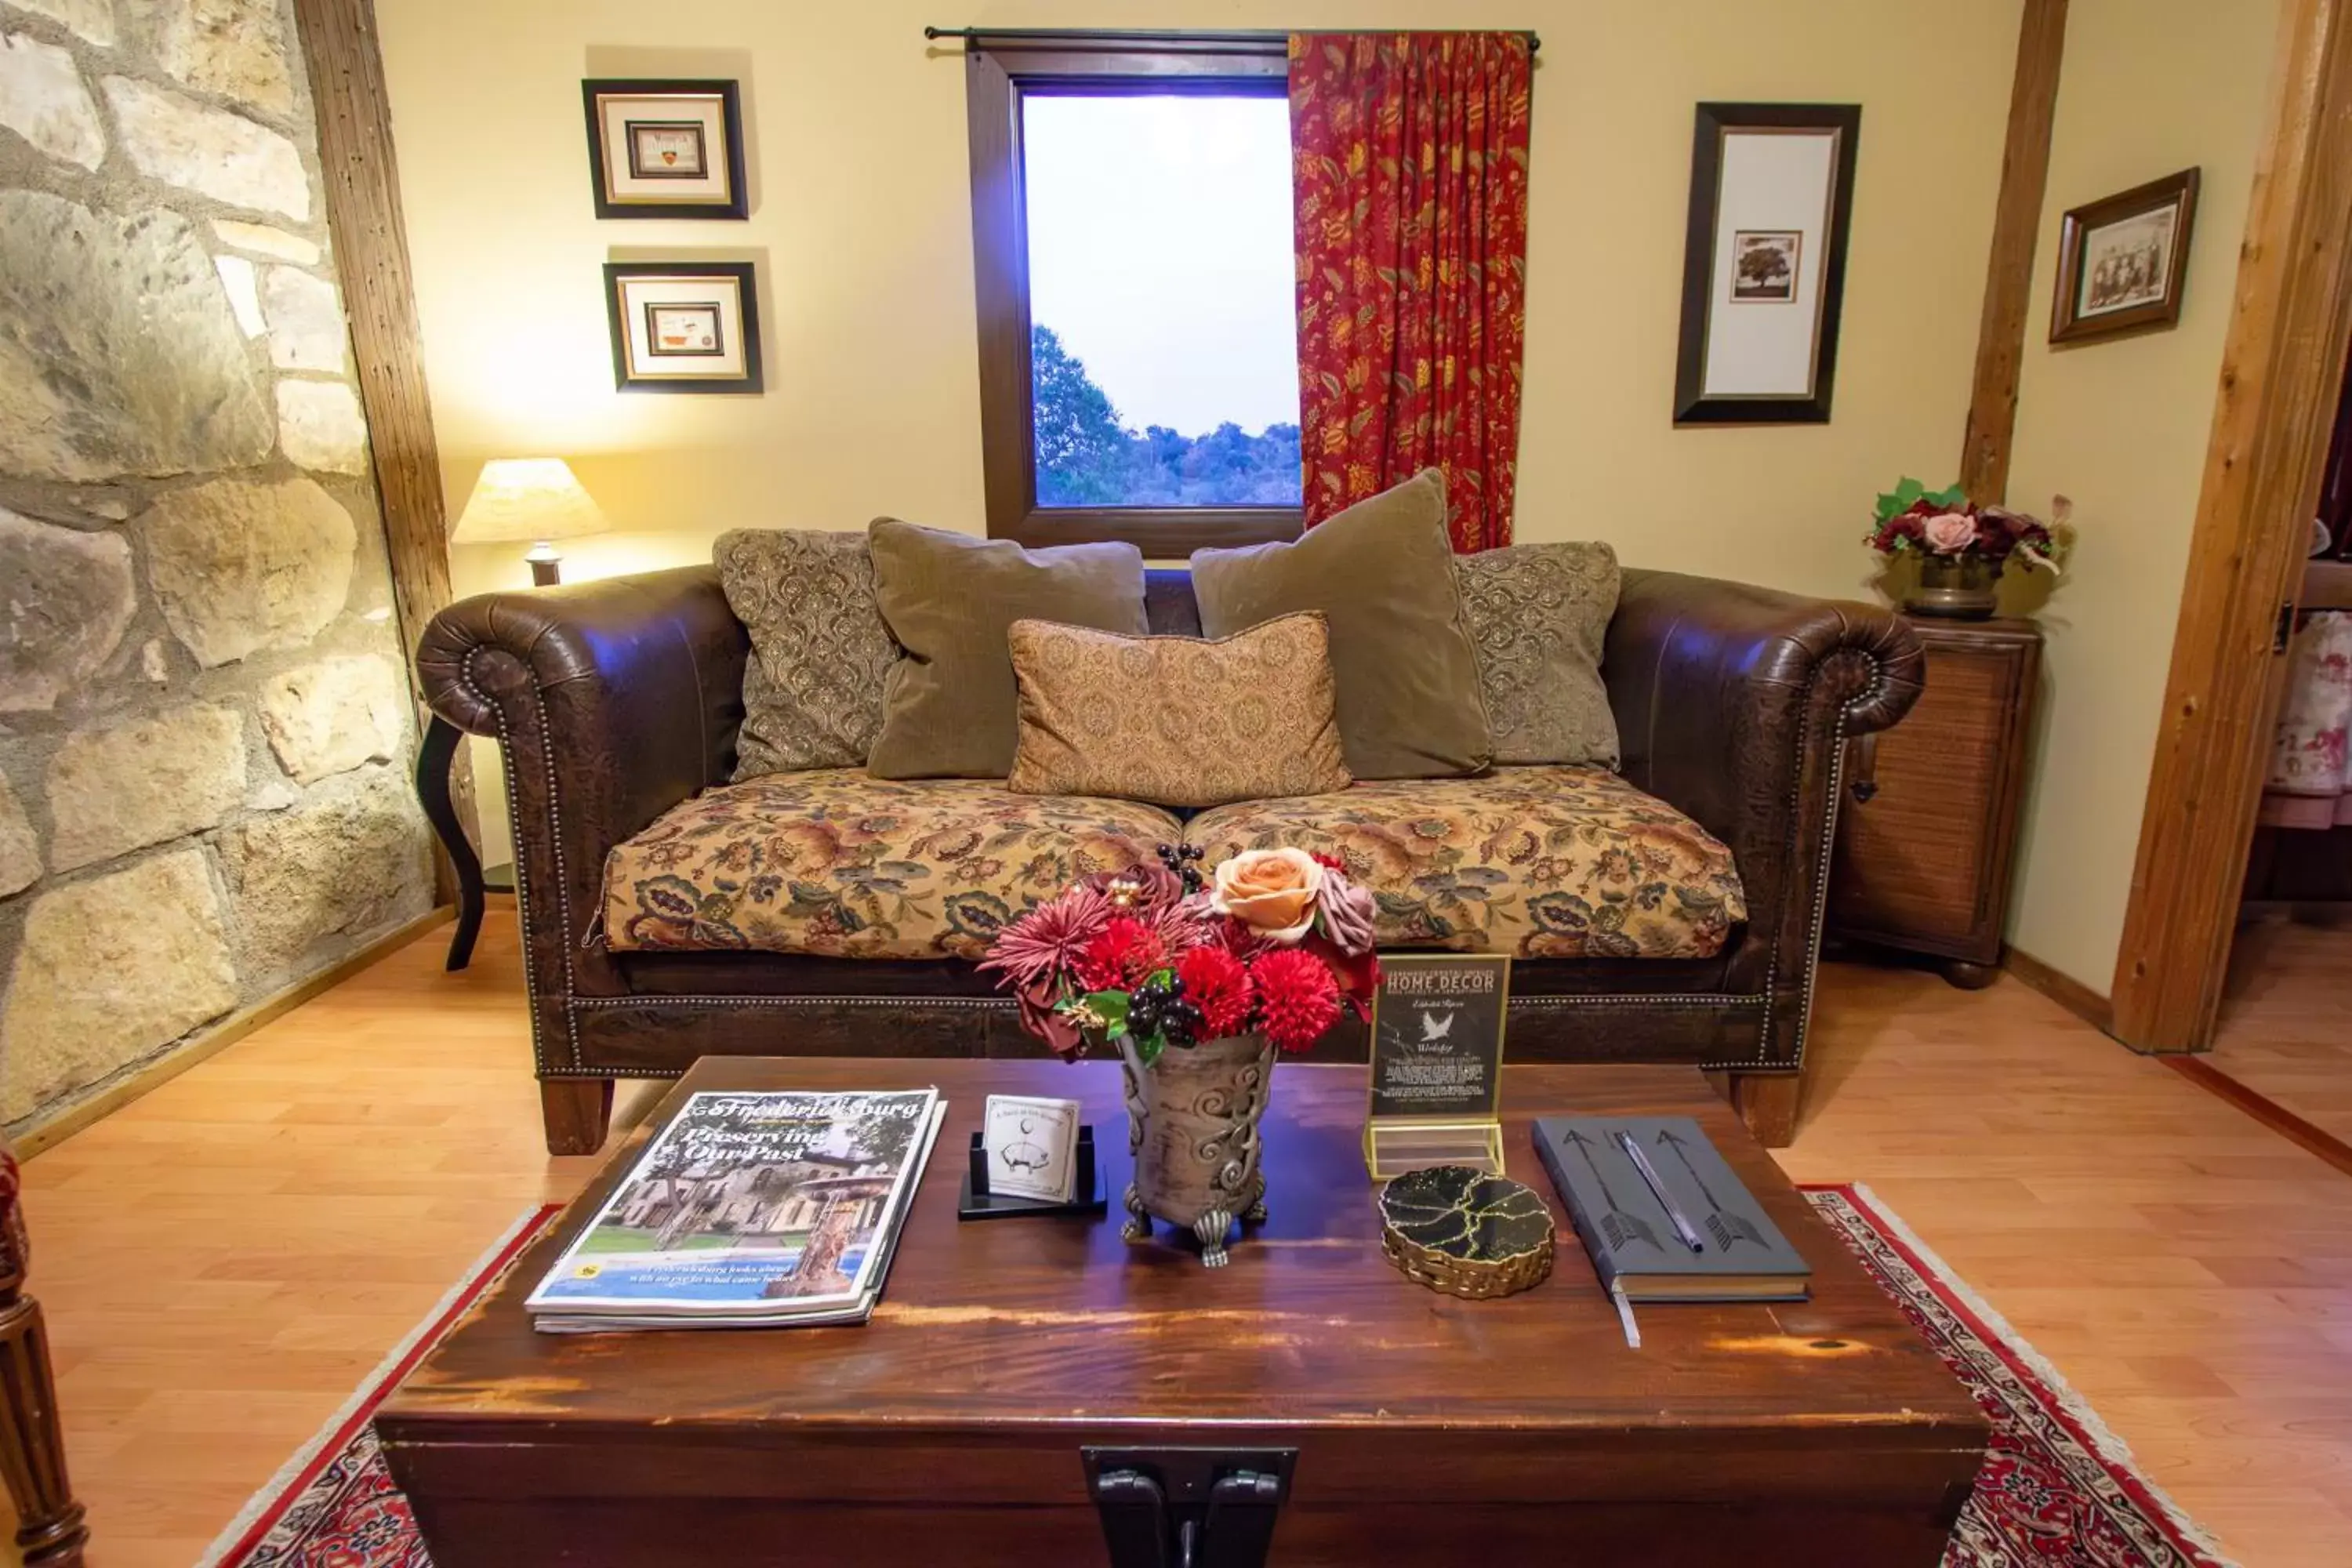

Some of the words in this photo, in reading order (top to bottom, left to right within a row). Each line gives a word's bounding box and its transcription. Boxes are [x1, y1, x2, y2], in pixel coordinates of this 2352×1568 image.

[1387, 975, 1433, 990] HOME
[1440, 975, 1495, 990] DECOR
[681, 1127, 826, 1146] Preserving
[684, 1144, 739, 1160] Our
[739, 1145, 805, 1160] Past
